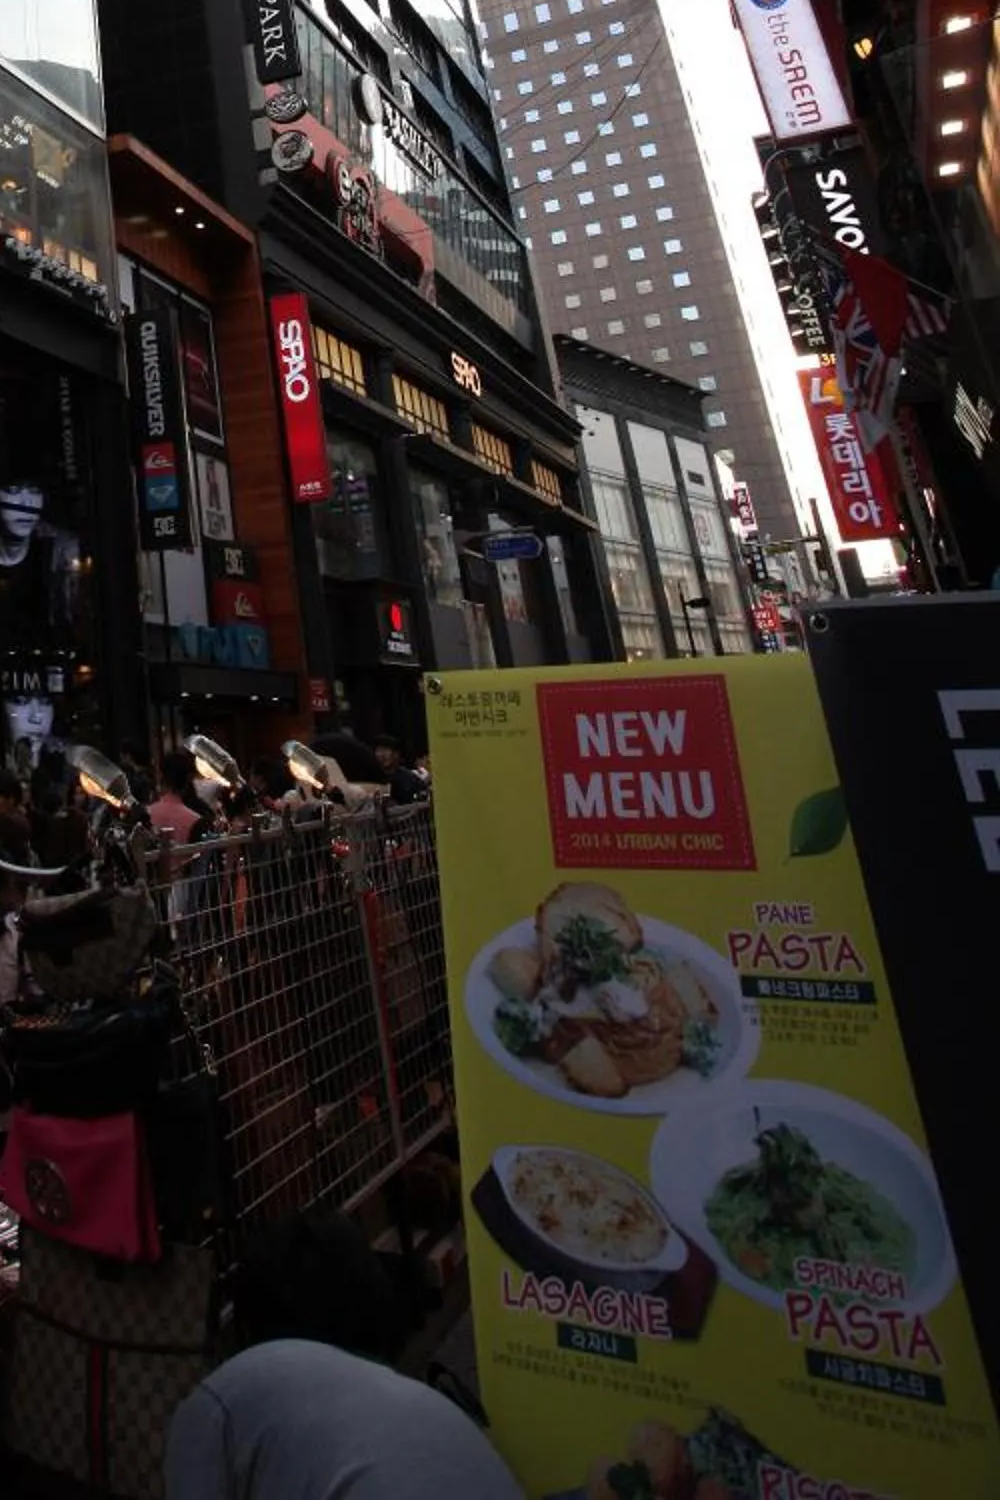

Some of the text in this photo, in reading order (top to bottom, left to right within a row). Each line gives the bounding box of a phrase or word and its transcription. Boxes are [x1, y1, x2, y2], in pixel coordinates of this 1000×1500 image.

[766, 12, 791, 47] the
[814, 168, 871, 256] SAVO
[139, 320, 166, 438] QUIKSILVER
[279, 318, 310, 403] SPAO
[450, 351, 482, 398] SPAO
[575, 709, 687, 758] NEW
[562, 770, 716, 820] MENU
[571, 832, 725, 851] 2014 URBAN CHIC
[755, 903, 814, 925] PANE
[728, 931, 864, 973] PASTA
[796, 1258, 905, 1300] SPINACH
[503, 1270, 673, 1339] LASAGNE
[786, 1291, 942, 1365] PASTA
